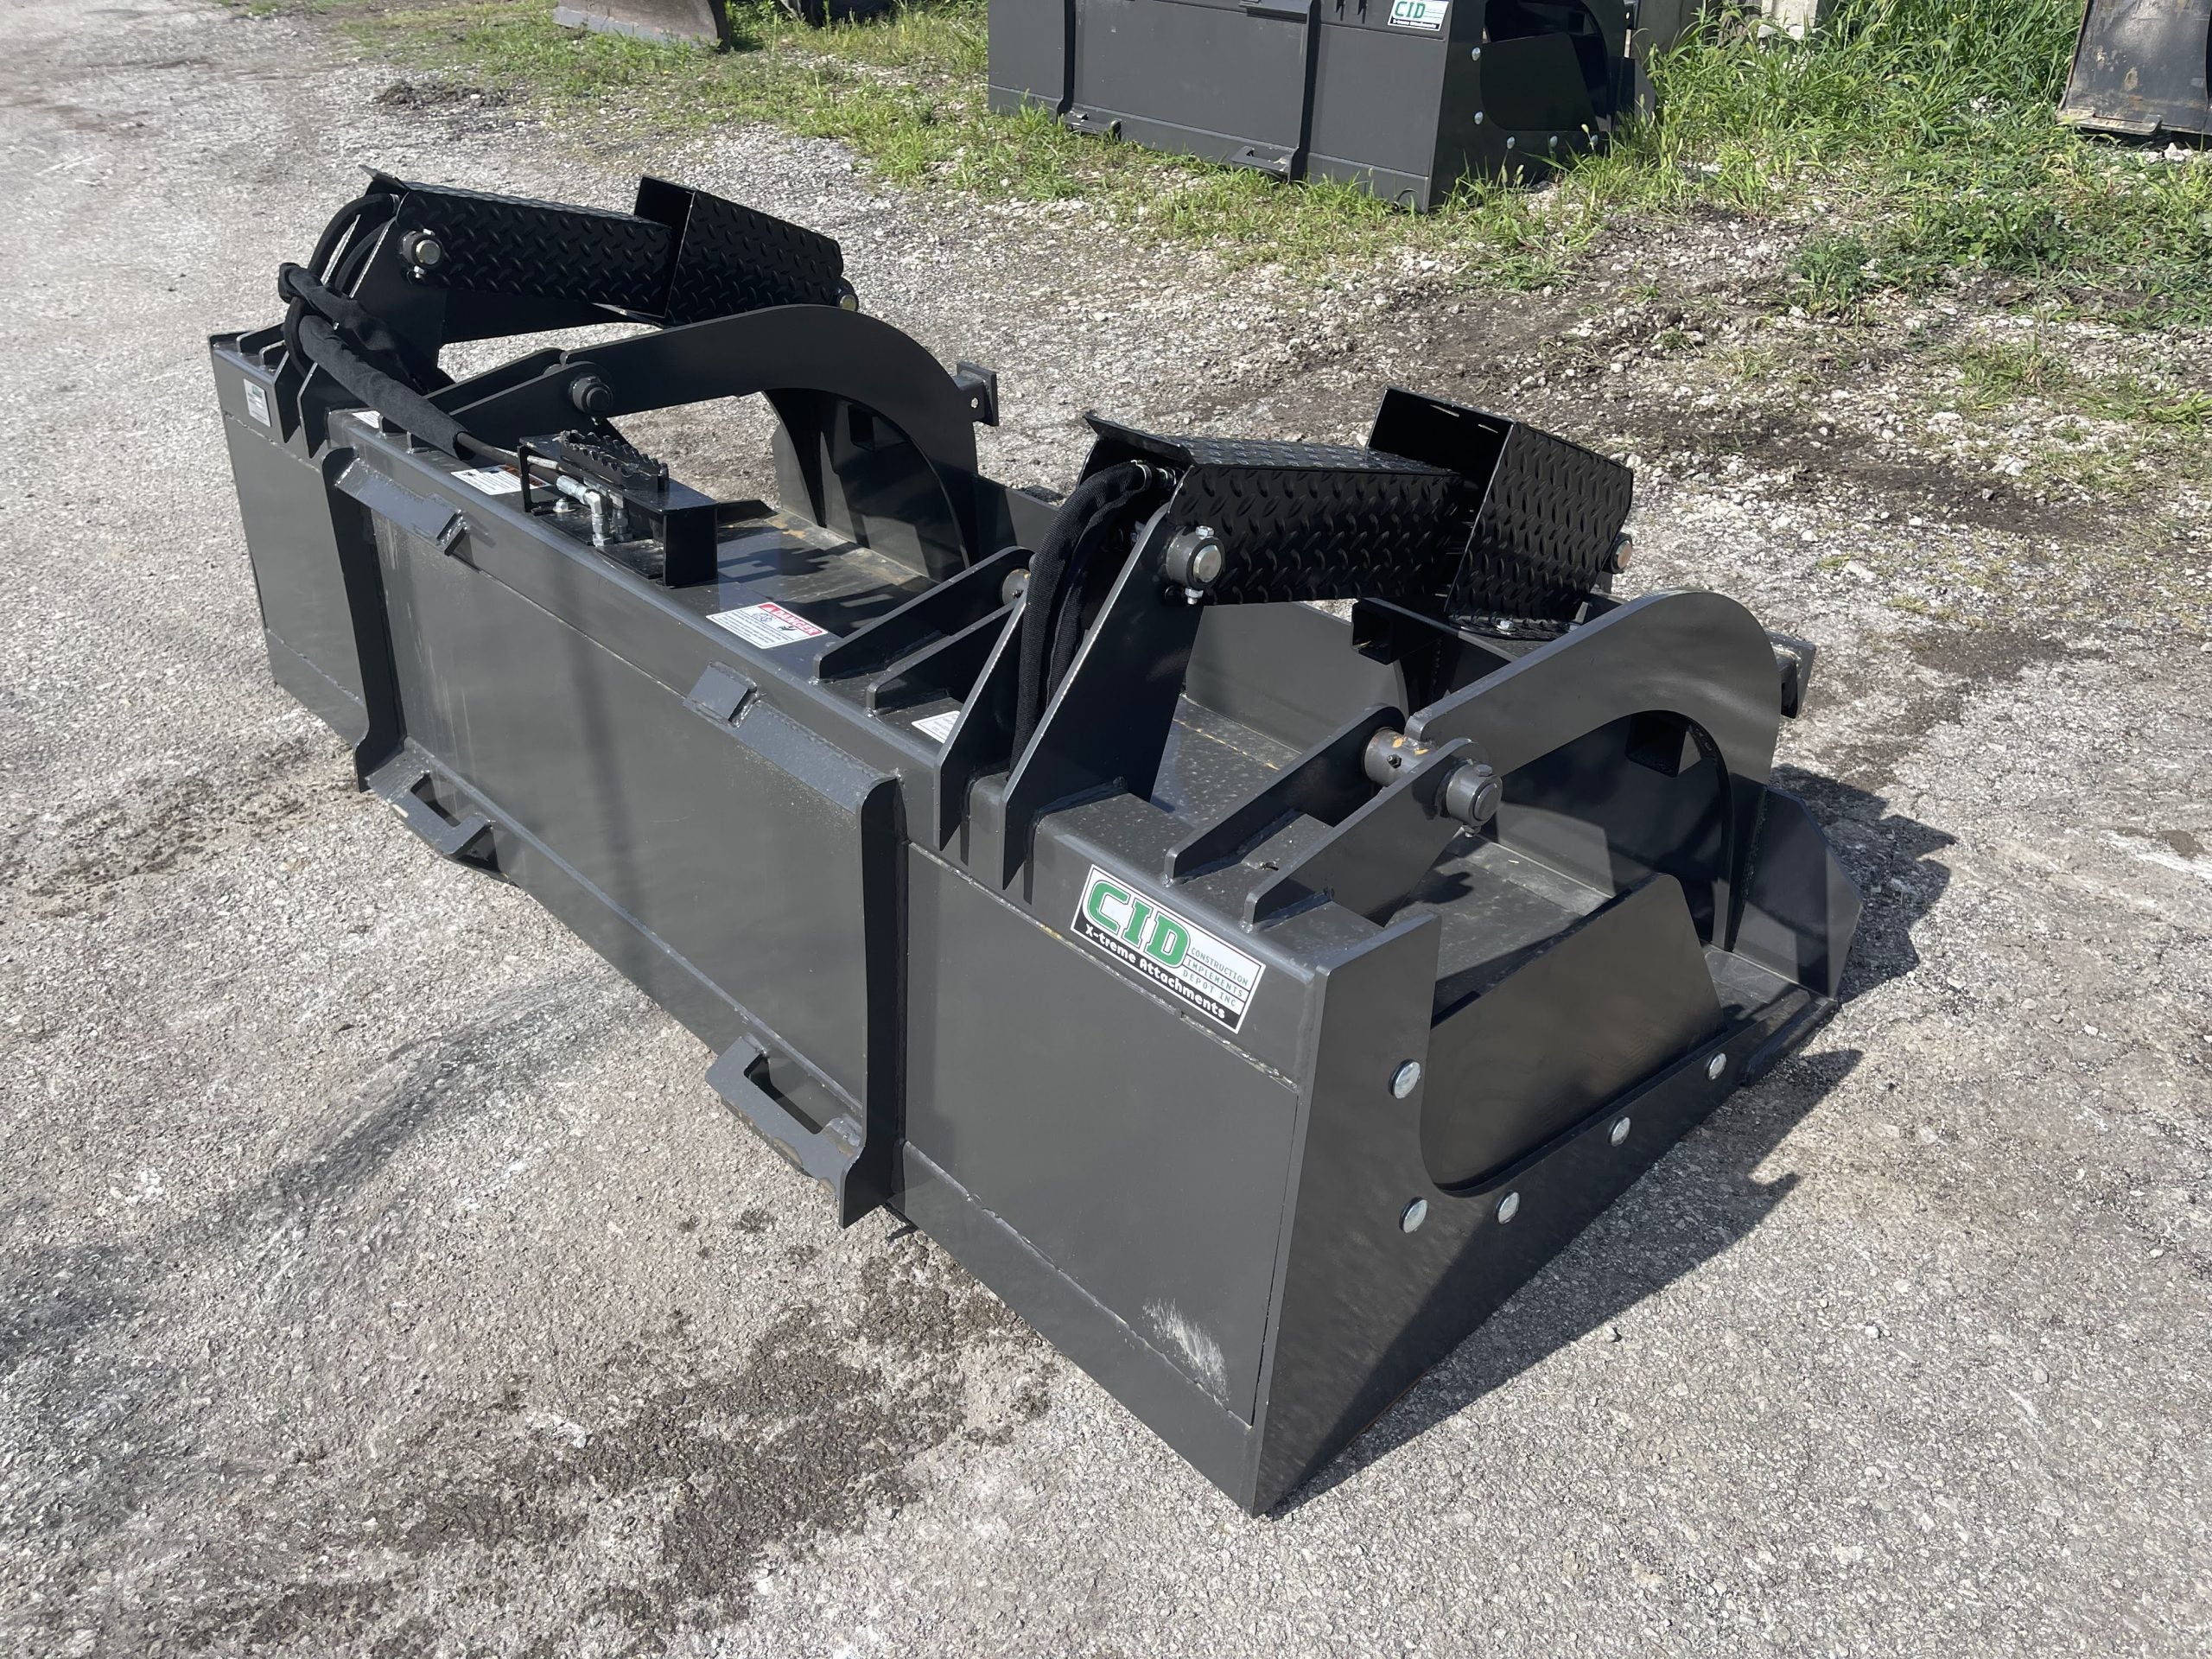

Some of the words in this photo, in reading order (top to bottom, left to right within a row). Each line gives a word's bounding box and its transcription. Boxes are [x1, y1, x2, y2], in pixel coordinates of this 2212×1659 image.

[1395, 1, 1426, 18] CID
[773, 608, 817, 635] DANGER
[1088, 880, 1190, 967] CID
[1085, 924, 1136, 963] X-treme
[1139, 958, 1225, 1019] Attachments
[1183, 969, 1215, 993] DEPOT
[1186, 958, 1243, 997] IMPLEMENTS
[1191, 947, 1249, 987] CONSTRUCTION
